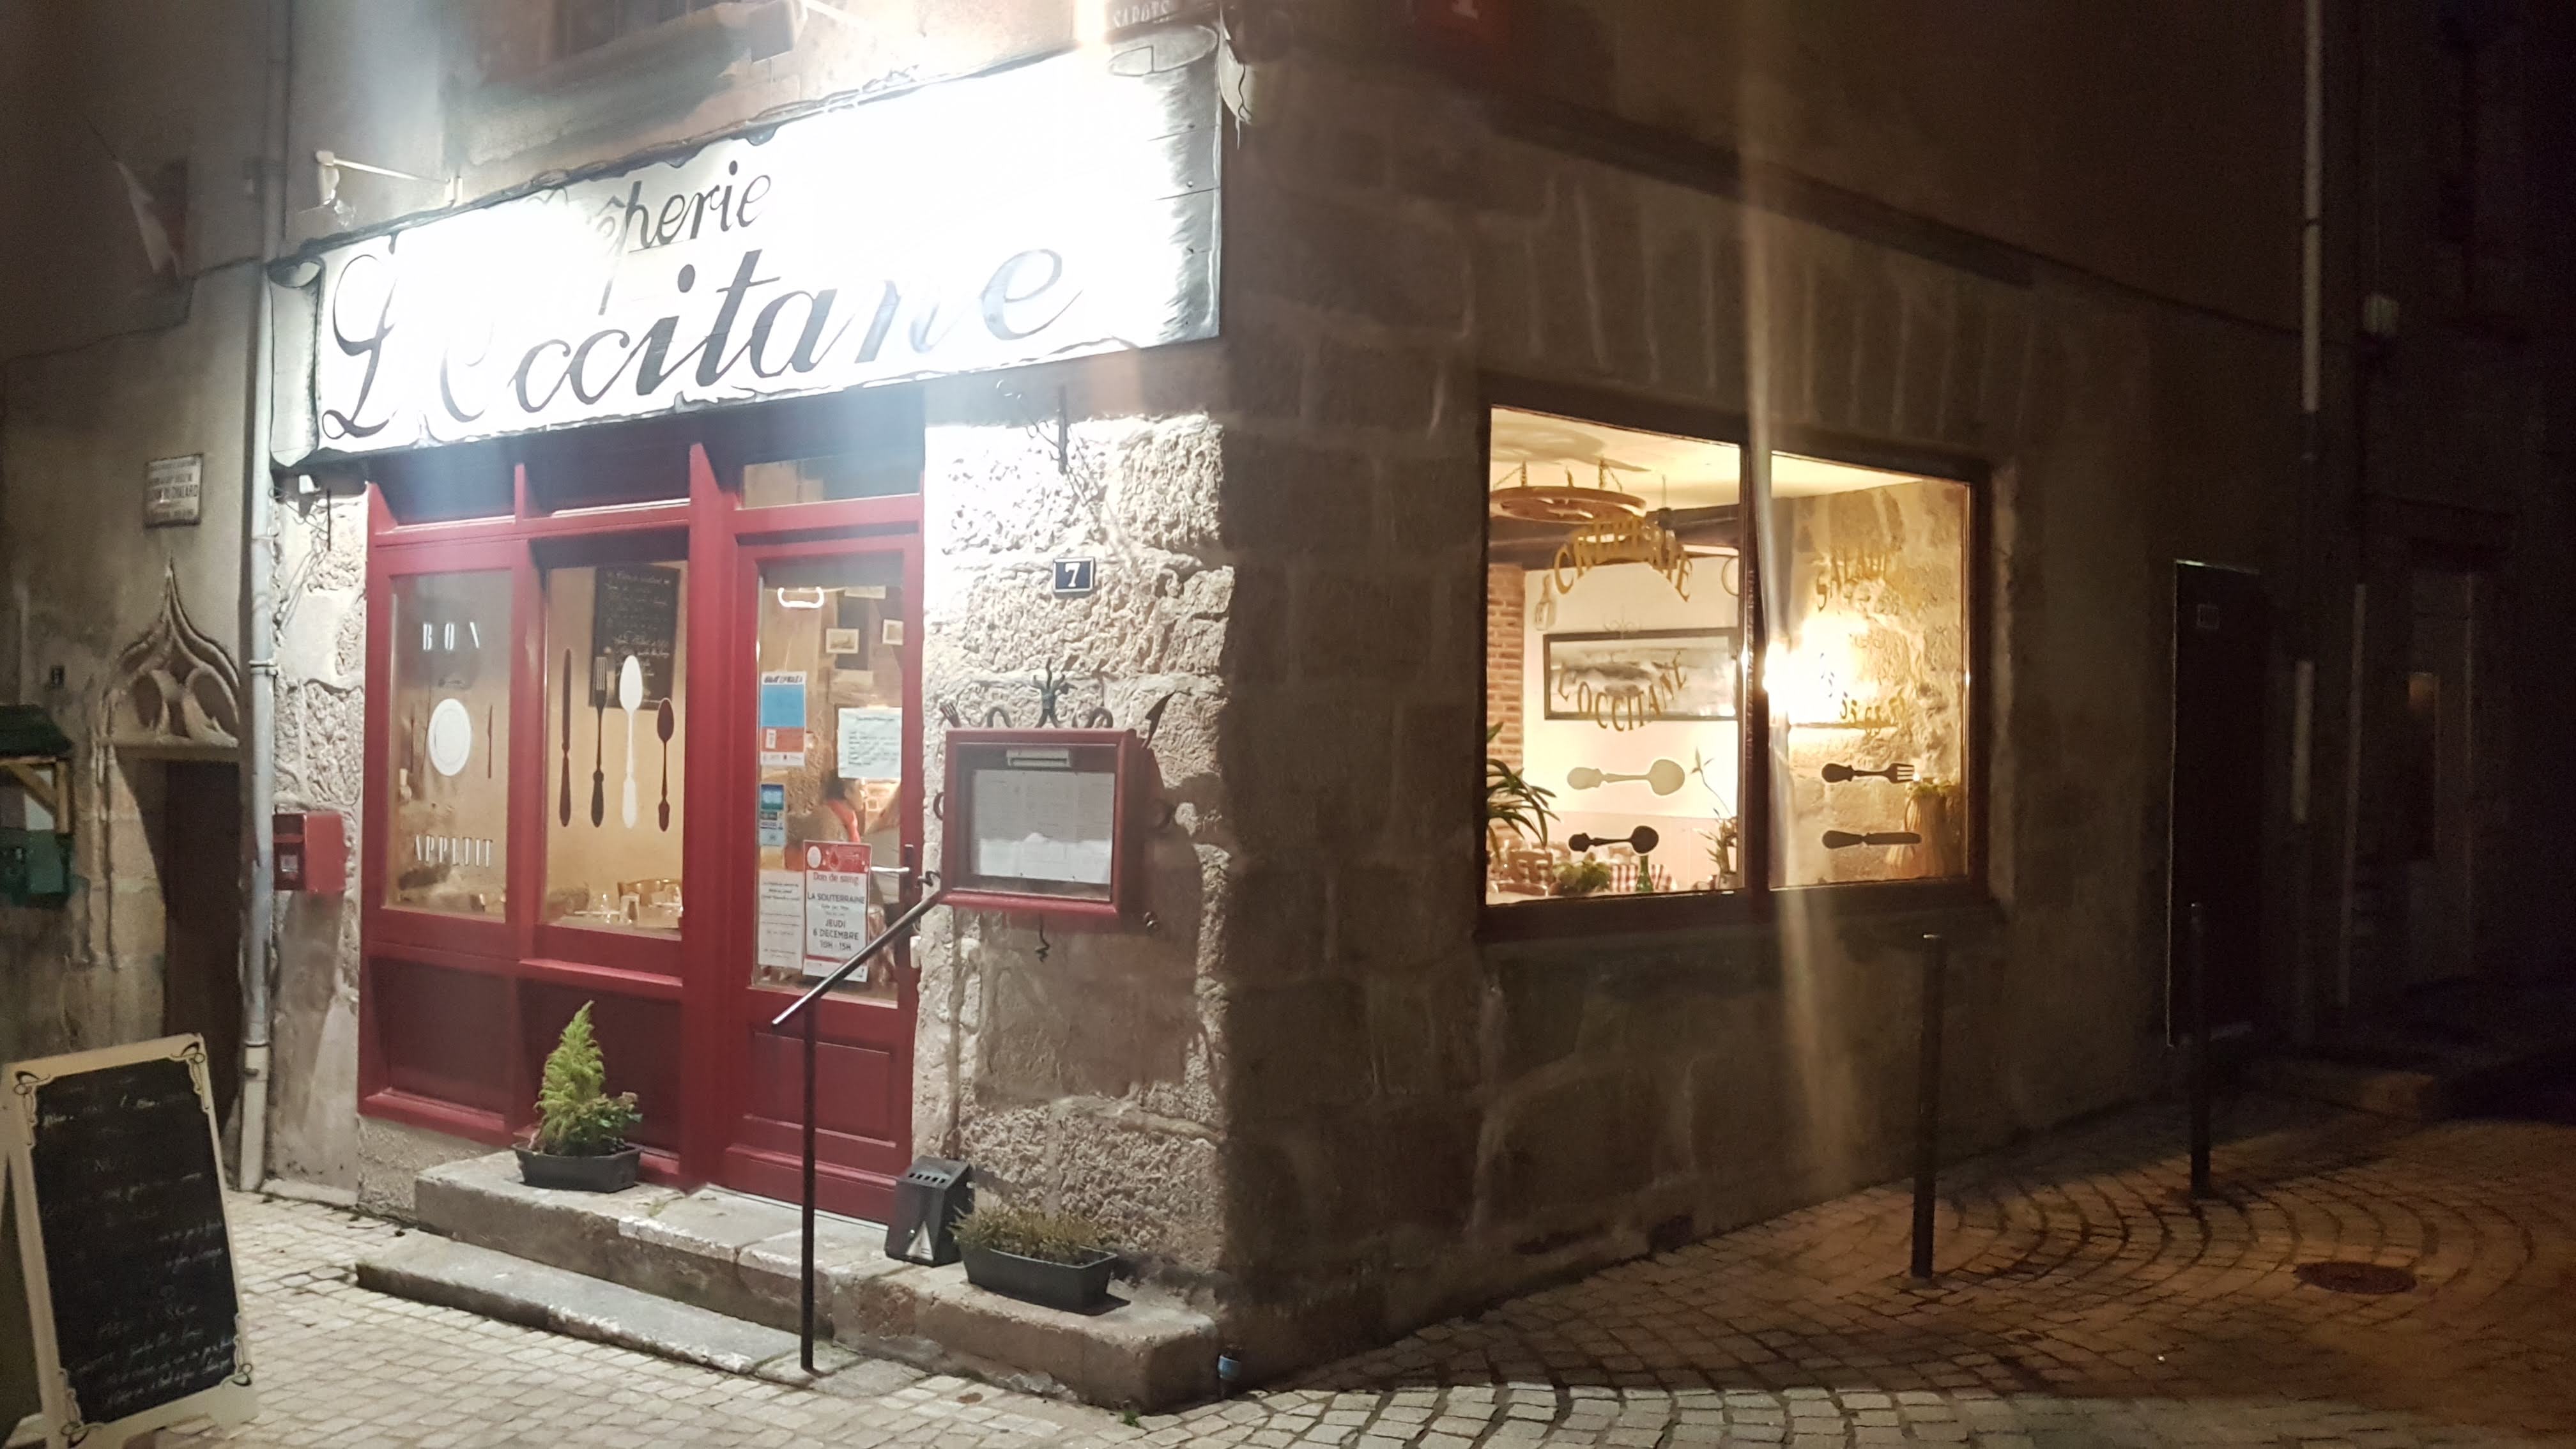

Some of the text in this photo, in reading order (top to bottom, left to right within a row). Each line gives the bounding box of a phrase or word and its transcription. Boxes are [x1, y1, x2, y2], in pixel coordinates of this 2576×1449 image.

[321, 248, 1084, 440] LOccitane
[1064, 562, 1082, 588] 7
[422, 622, 481, 651] BON
[414, 835, 494, 868] APPETIT
[807, 892, 865, 904] LA SOUTERRAINE
[813, 928, 818, 937] 6
[825, 919, 846, 928] JEUDI
